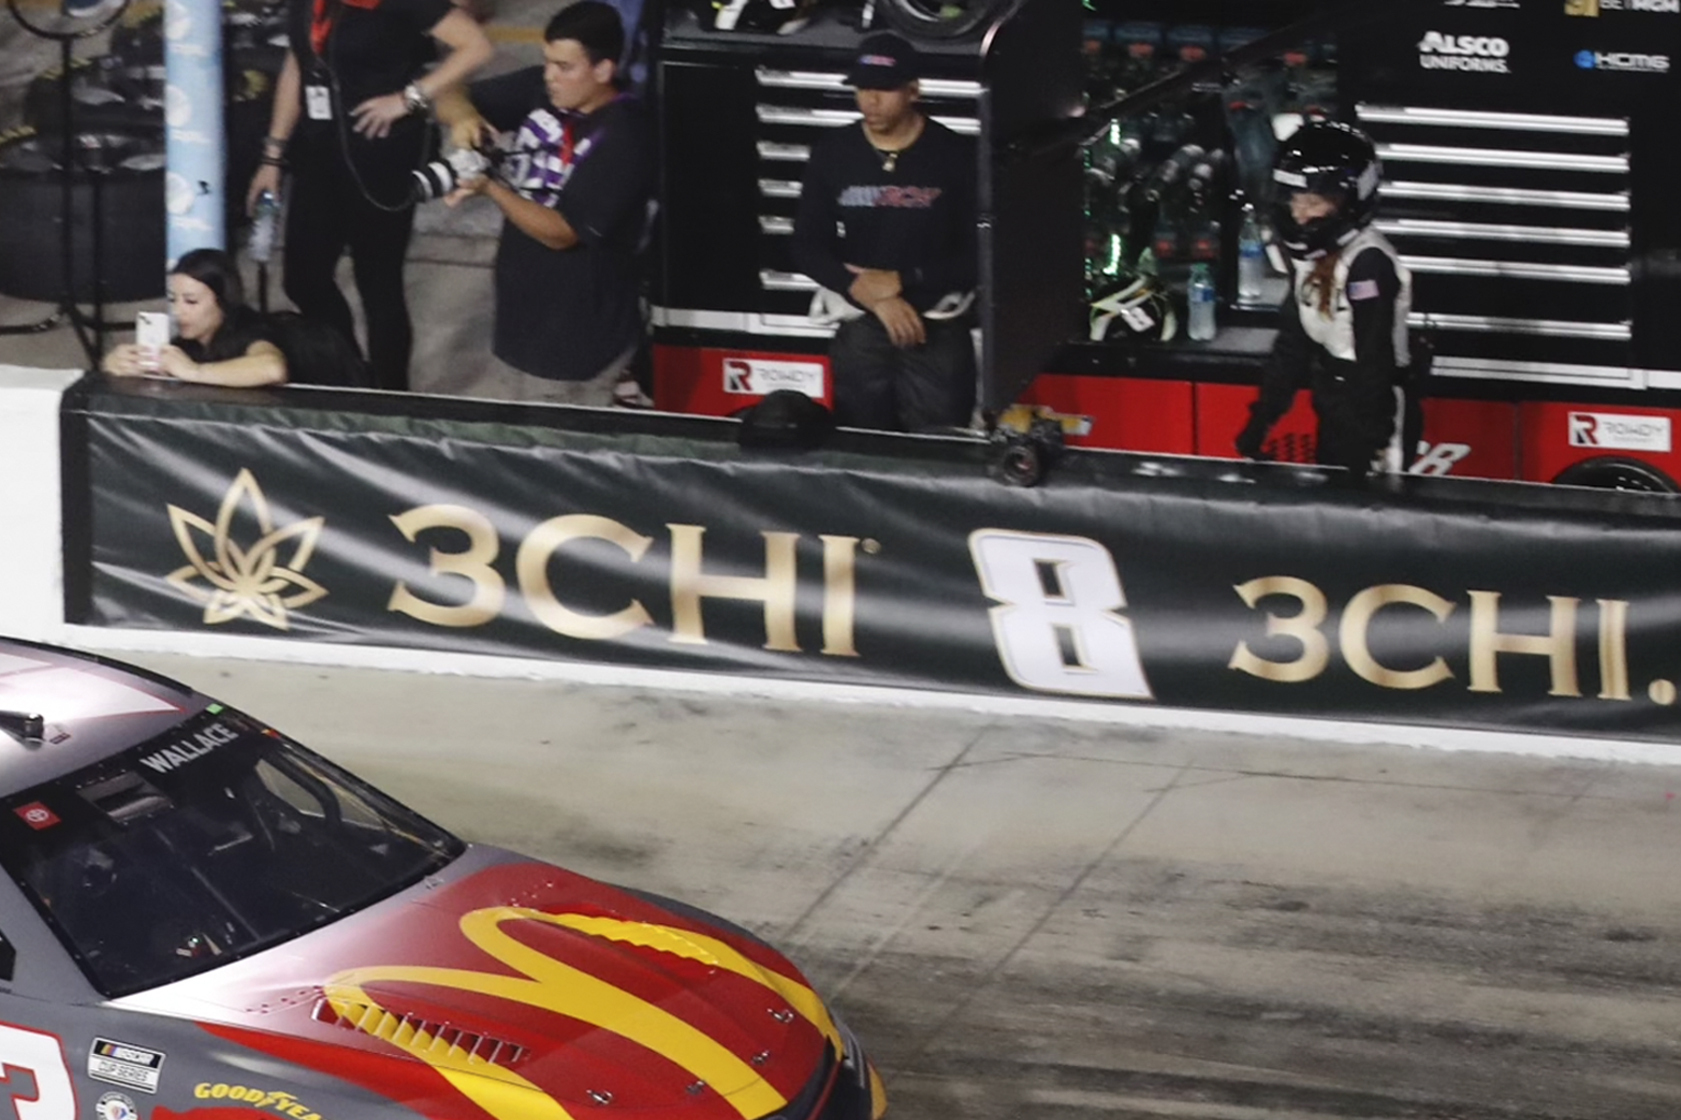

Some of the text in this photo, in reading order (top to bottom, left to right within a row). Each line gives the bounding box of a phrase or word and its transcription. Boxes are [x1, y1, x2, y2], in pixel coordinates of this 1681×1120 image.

[1416, 30, 1510, 56] ALSCO
[968, 528, 1153, 700] 8
[140, 721, 239, 775] WALLACE
